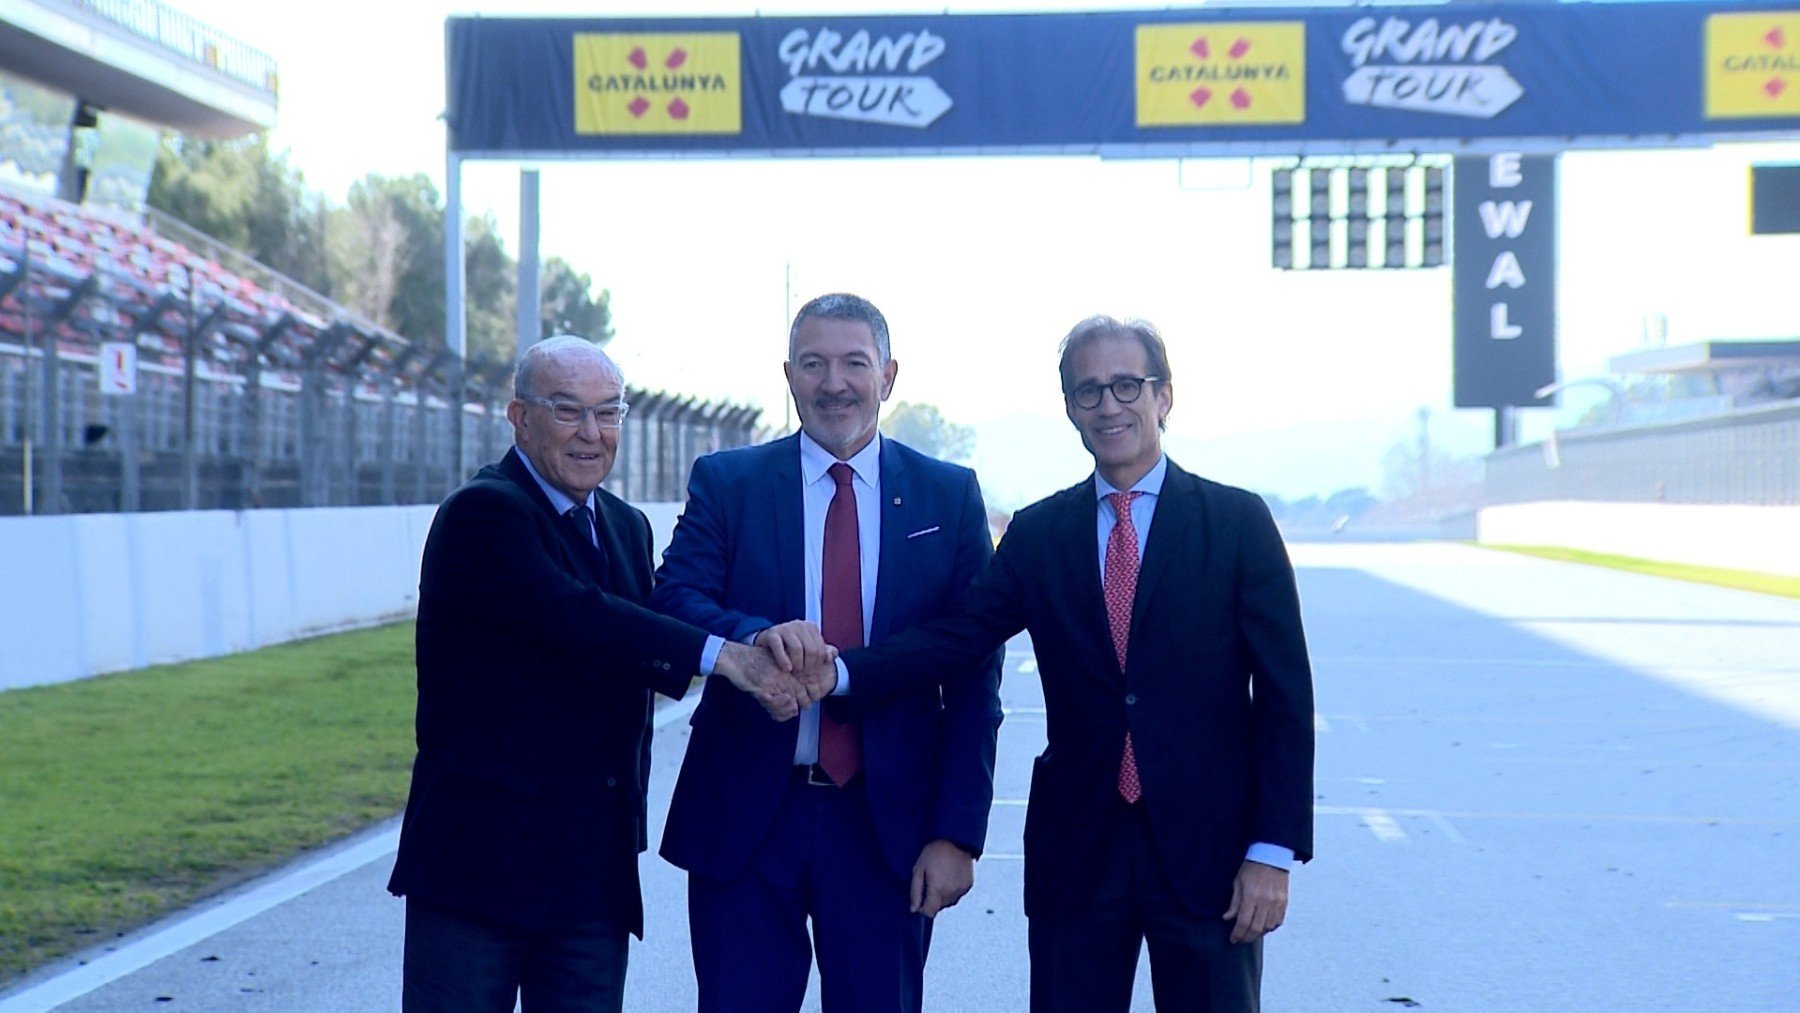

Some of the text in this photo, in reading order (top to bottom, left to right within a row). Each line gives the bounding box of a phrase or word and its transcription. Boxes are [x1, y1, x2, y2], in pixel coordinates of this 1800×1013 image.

[778, 27, 946, 76] GRAND
[1341, 16, 1518, 68] GRAND
[588, 73, 727, 92] CATALUNYA
[1149, 63, 1290, 82] CATALUNYA
[1367, 67, 1488, 105] TOUR
[800, 80, 923, 116] TOUR
